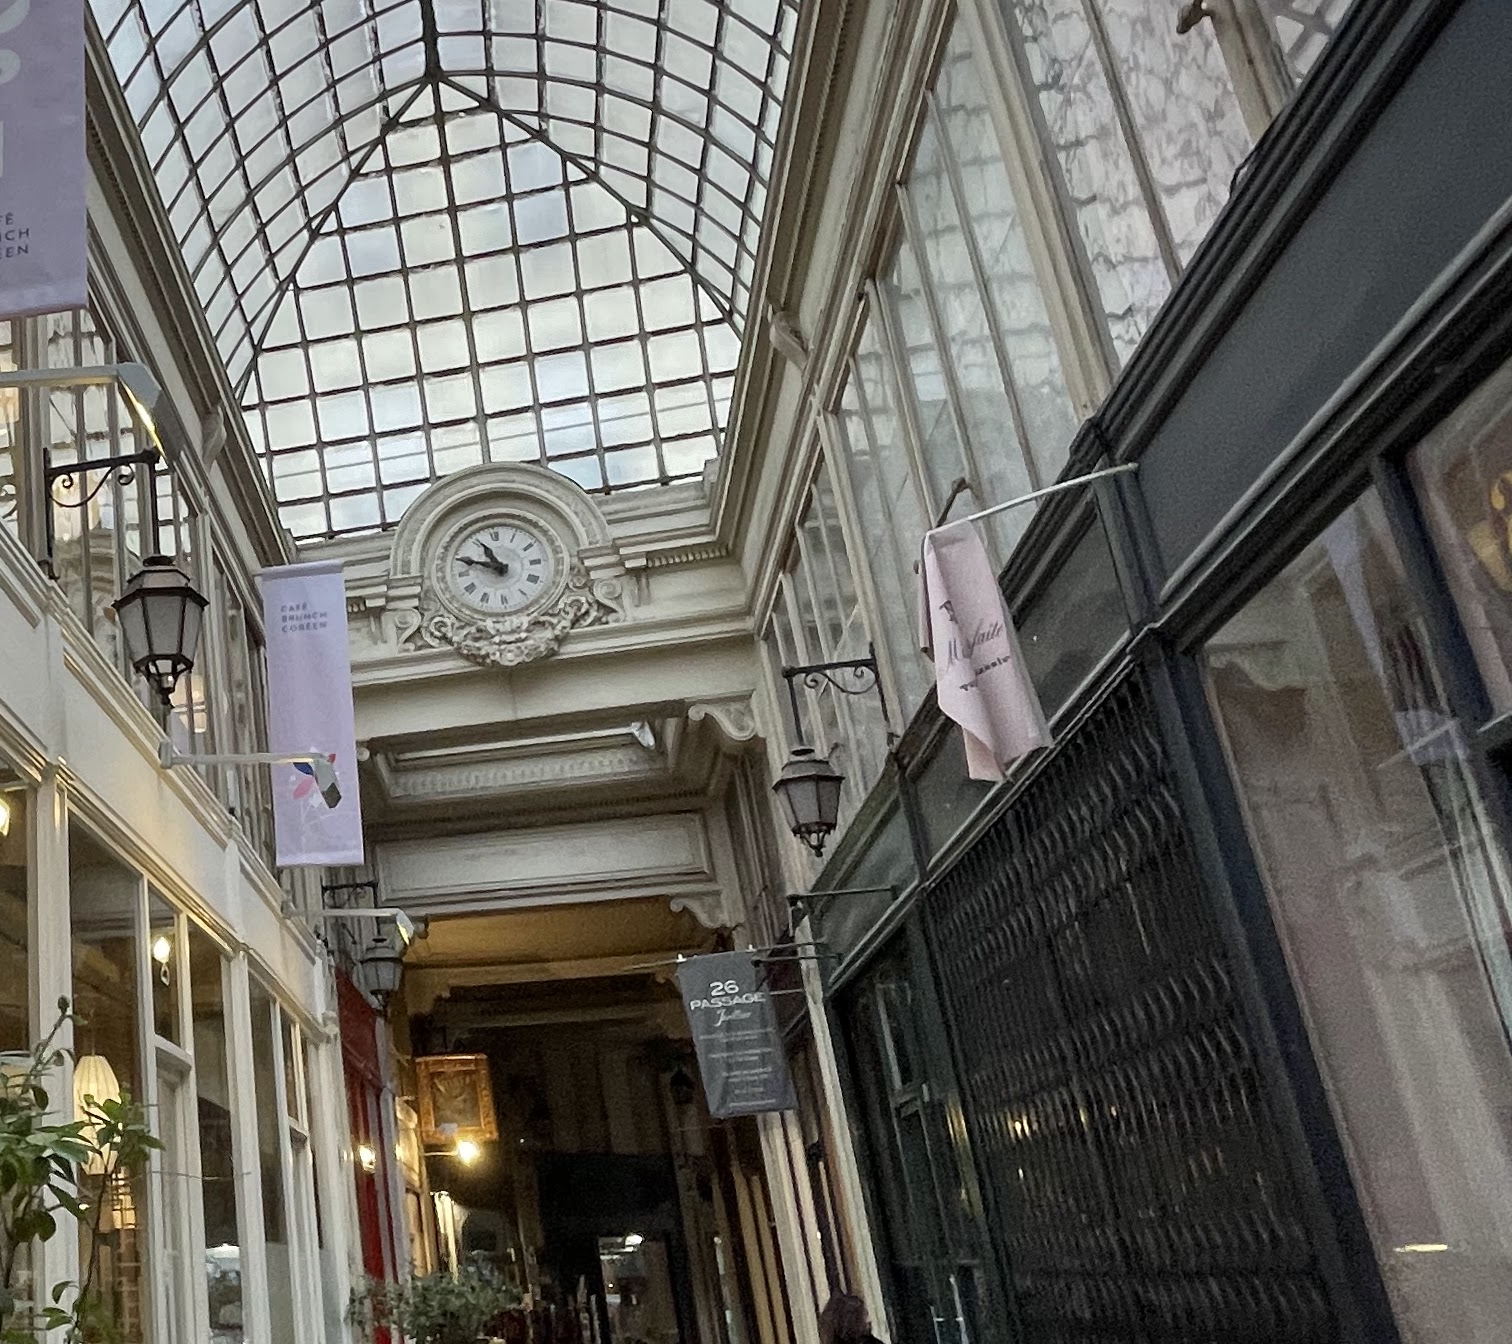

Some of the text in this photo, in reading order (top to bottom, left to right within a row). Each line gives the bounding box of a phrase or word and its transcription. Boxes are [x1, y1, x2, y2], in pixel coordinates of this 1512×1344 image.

[281, 611, 328, 624] BRUNCH
[708, 979, 740, 997] 26
[689, 991, 767, 1011] PASSAGE
